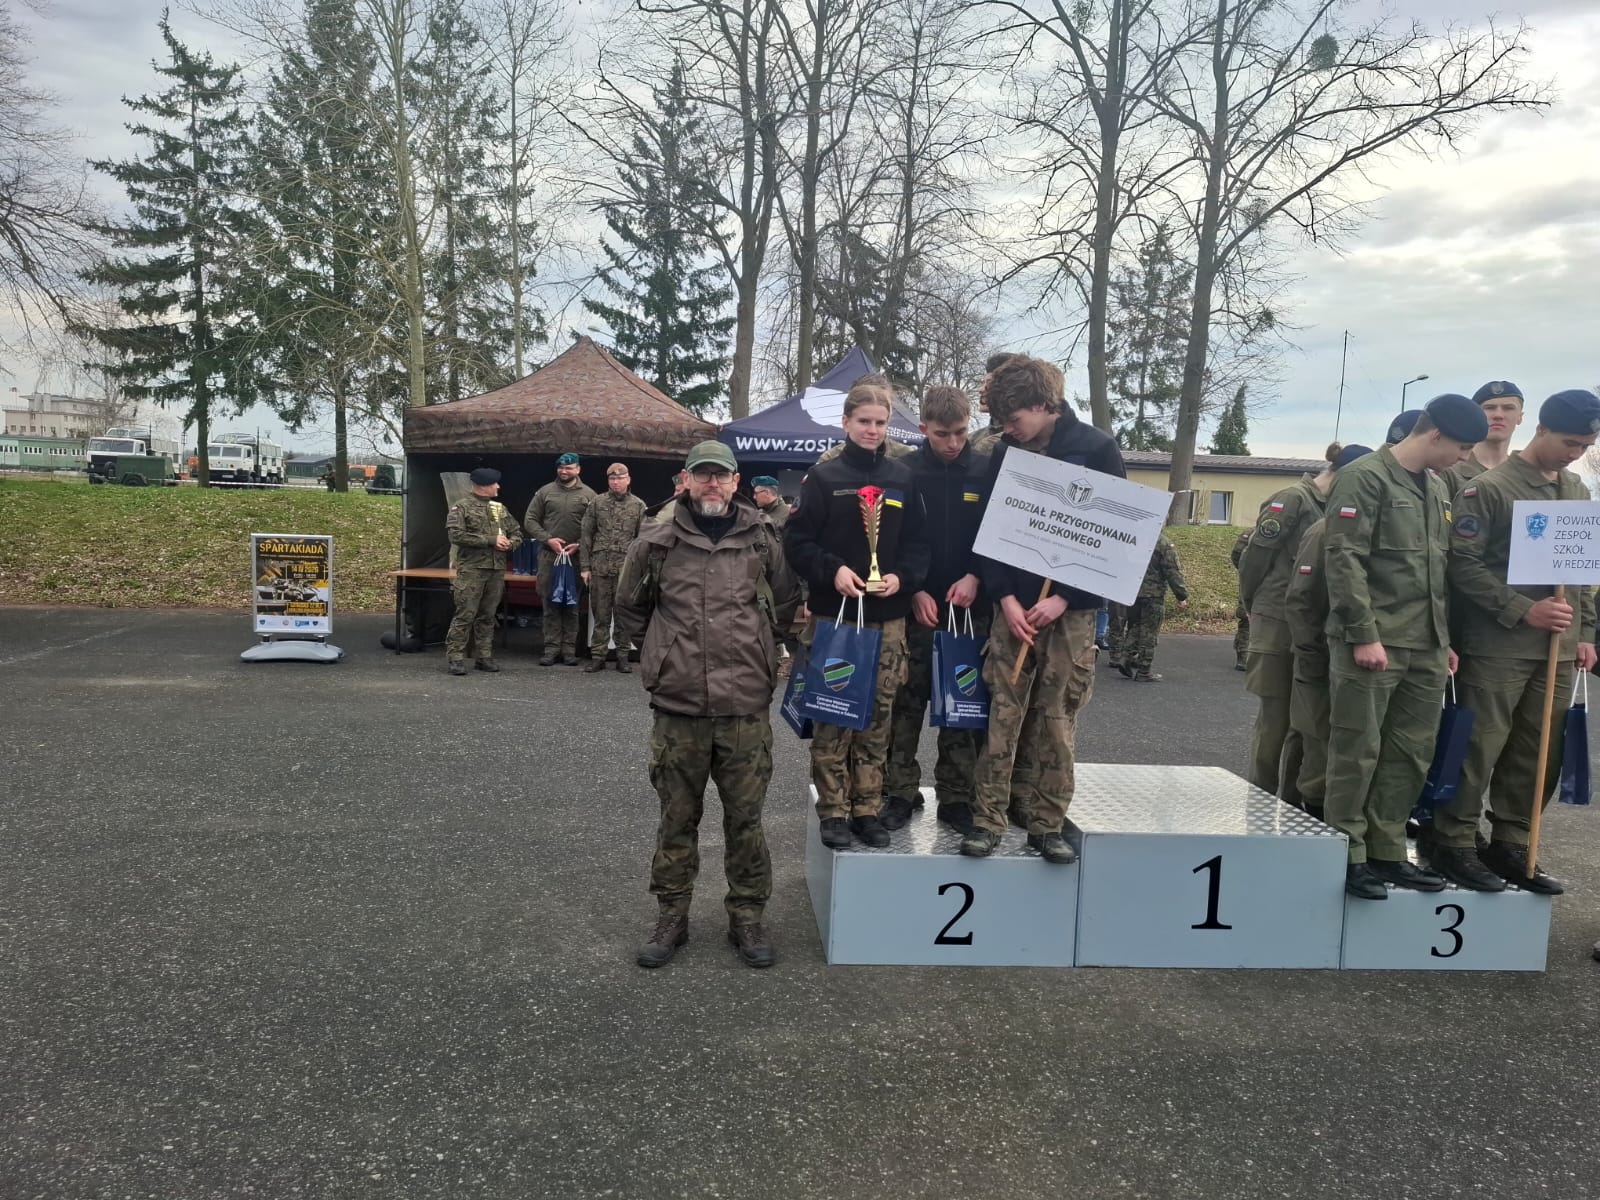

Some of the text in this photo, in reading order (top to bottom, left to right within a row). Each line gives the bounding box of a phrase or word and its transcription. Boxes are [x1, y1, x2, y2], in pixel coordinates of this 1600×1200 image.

[1005, 496, 1047, 518] ODDZIAŁ
[1049, 510, 1137, 546] PRZYGOTOWANIA
[1029, 518, 1102, 549] WOJSKOWEGO
[259, 543, 324, 554] SPARTAKIADA
[1553, 559, 1600, 569] W REDZIE
[934, 883, 975, 946] 2
[1192, 856, 1233, 930] 1
[1430, 903, 1465, 958] 3
